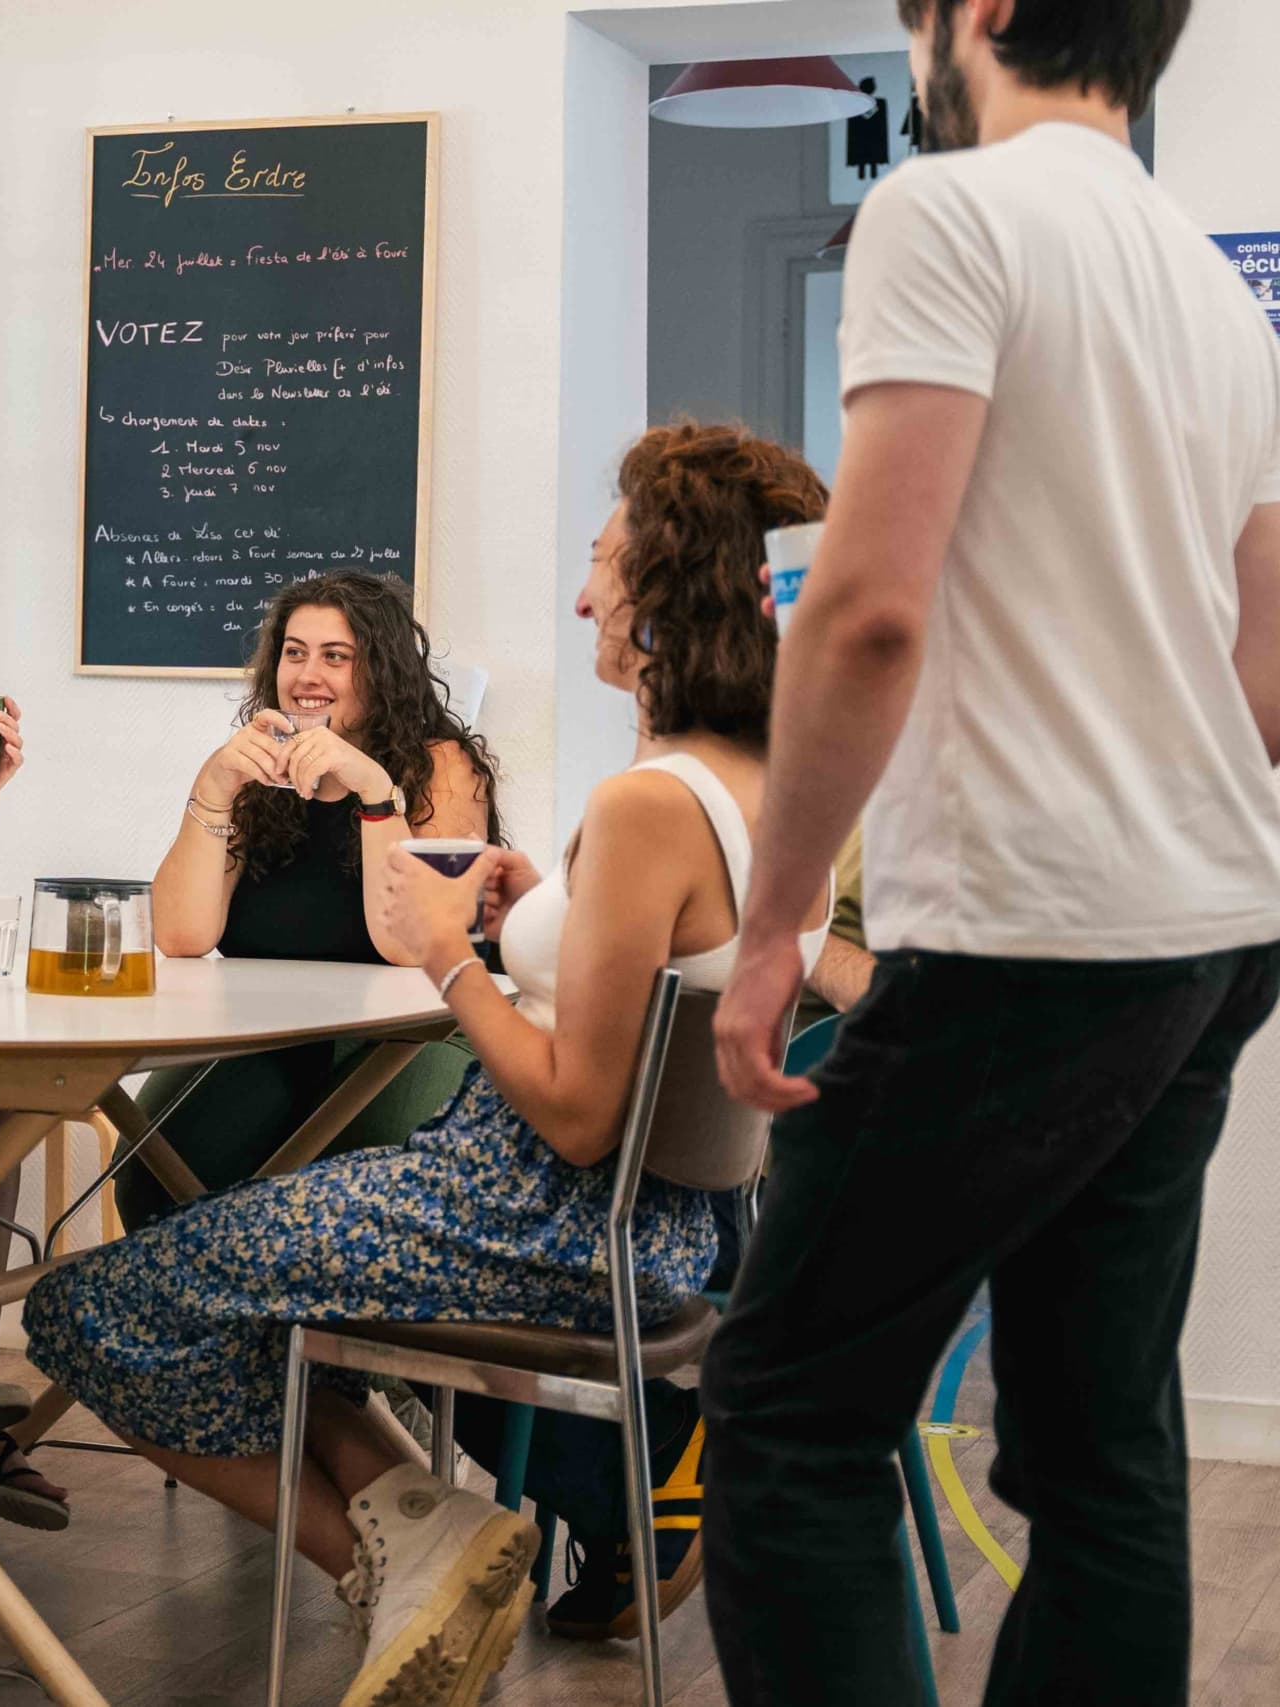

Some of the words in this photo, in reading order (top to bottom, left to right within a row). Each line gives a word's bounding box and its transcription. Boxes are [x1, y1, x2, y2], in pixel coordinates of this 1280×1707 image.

[122, 142, 205, 208] Infos
[224, 149, 305, 191] Erdre
[144, 250, 167, 269] 24
[296, 251, 311, 262] de
[356, 246, 367, 258] à
[96, 320, 204, 347] VOTEZ
[223, 333, 248, 352] pour
[288, 329, 309, 345] jour
[363, 331, 390, 345] pour
[357, 354, 405, 373] d'infos
[218, 388, 243, 400] dans
[271, 385, 329, 399] Newsletter
[338, 386, 352, 398] de
[122, 411, 199, 431] changement
[207, 417, 224, 427] de
[232, 415, 267, 428] dates
[186, 440, 224, 453] Mardi
[234, 440, 246, 456] 5
[256, 443, 280, 451] nov
[178, 462, 236, 476] Mercredi
[247, 461, 259, 475] 6
[266, 464, 287, 473] nov
[229, 483, 239, 494] 7
[253, 484, 275, 493] nov
[94, 523, 160, 543] Absences
[167, 530, 182, 541] de
[232, 548, 241, 560] à
[285, 550, 324, 559] semaine
[330, 550, 346, 559] du
[215, 575, 253, 585] mardi
[264, 572, 283, 584] 30
[144, 601, 160, 612] En
[166, 602, 203, 617] congés
[225, 599, 244, 612] du
[223, 619, 242, 632] du
